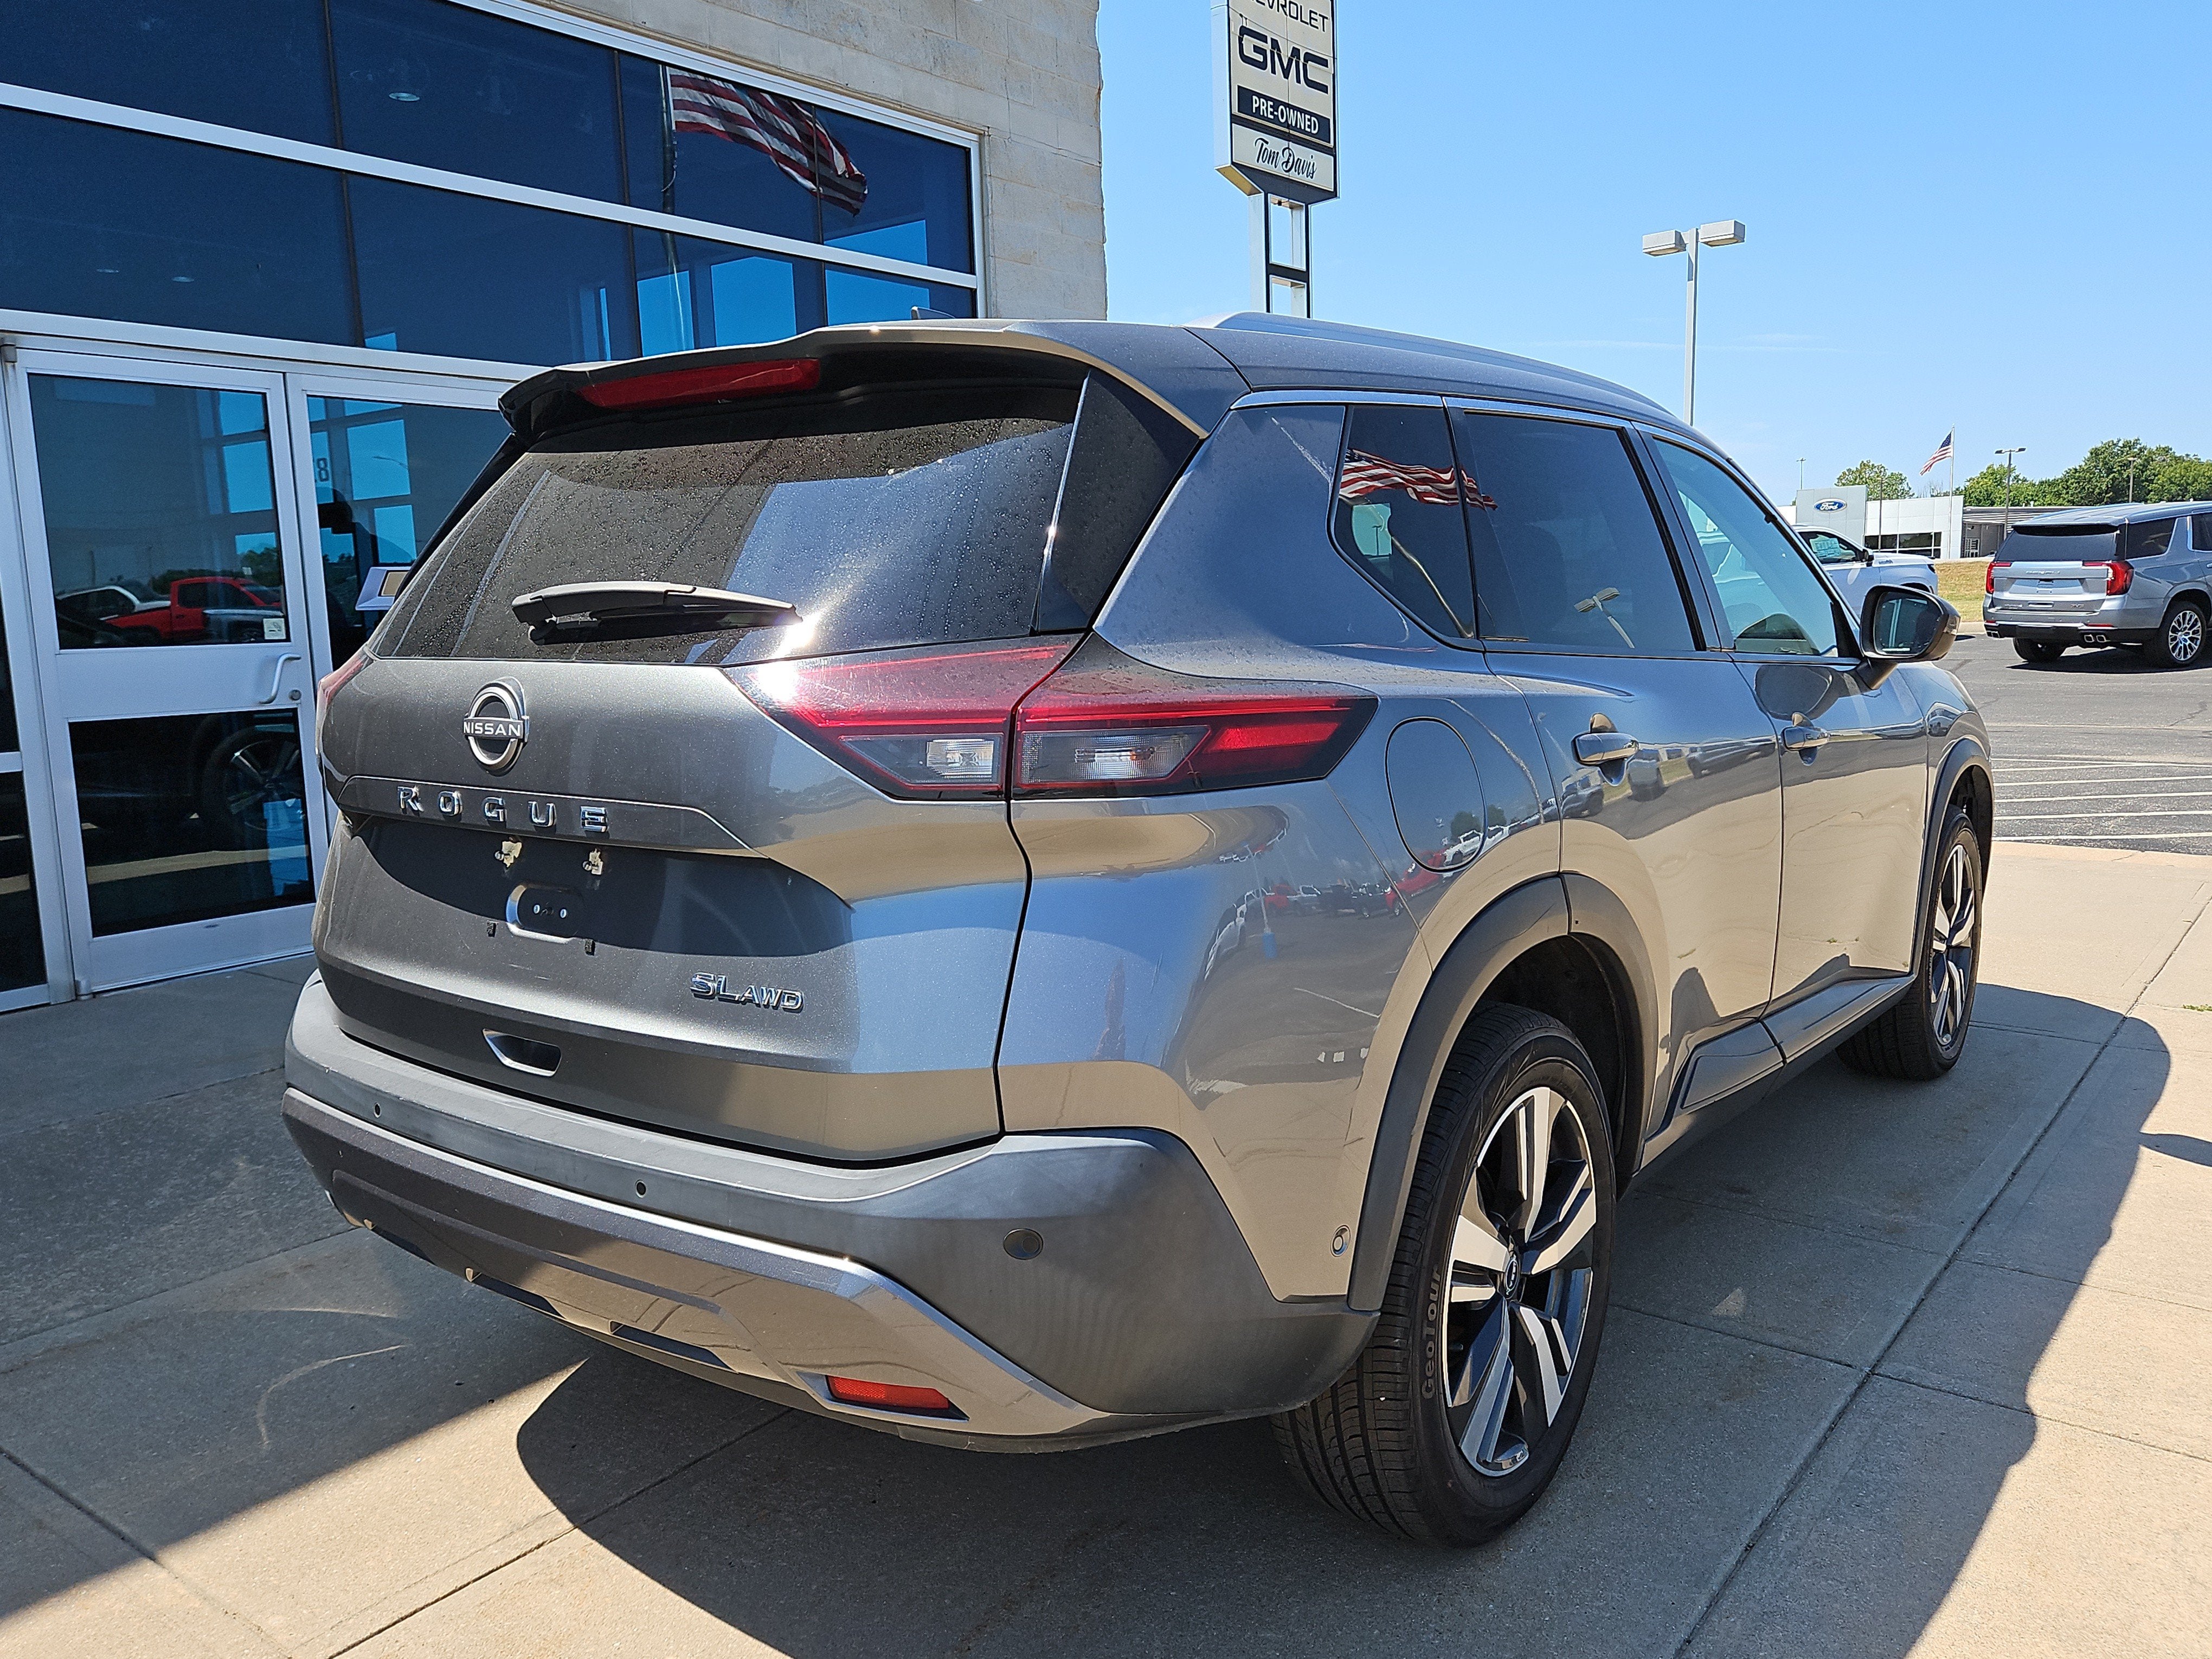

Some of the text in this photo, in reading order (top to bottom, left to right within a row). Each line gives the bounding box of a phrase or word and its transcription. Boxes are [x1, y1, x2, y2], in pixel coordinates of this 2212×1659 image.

[1238, 25, 1329, 94] GMC
[1252, 95, 1319, 134] PRE-OWNED
[1254, 137, 1317, 179] Tom Davis
[1819, 502, 1838, 511] Ford
[464, 721, 521, 737] NISSAN
[397, 785, 609, 833] ROGUE
[1422, 1264, 1441, 1399] GeoTour
